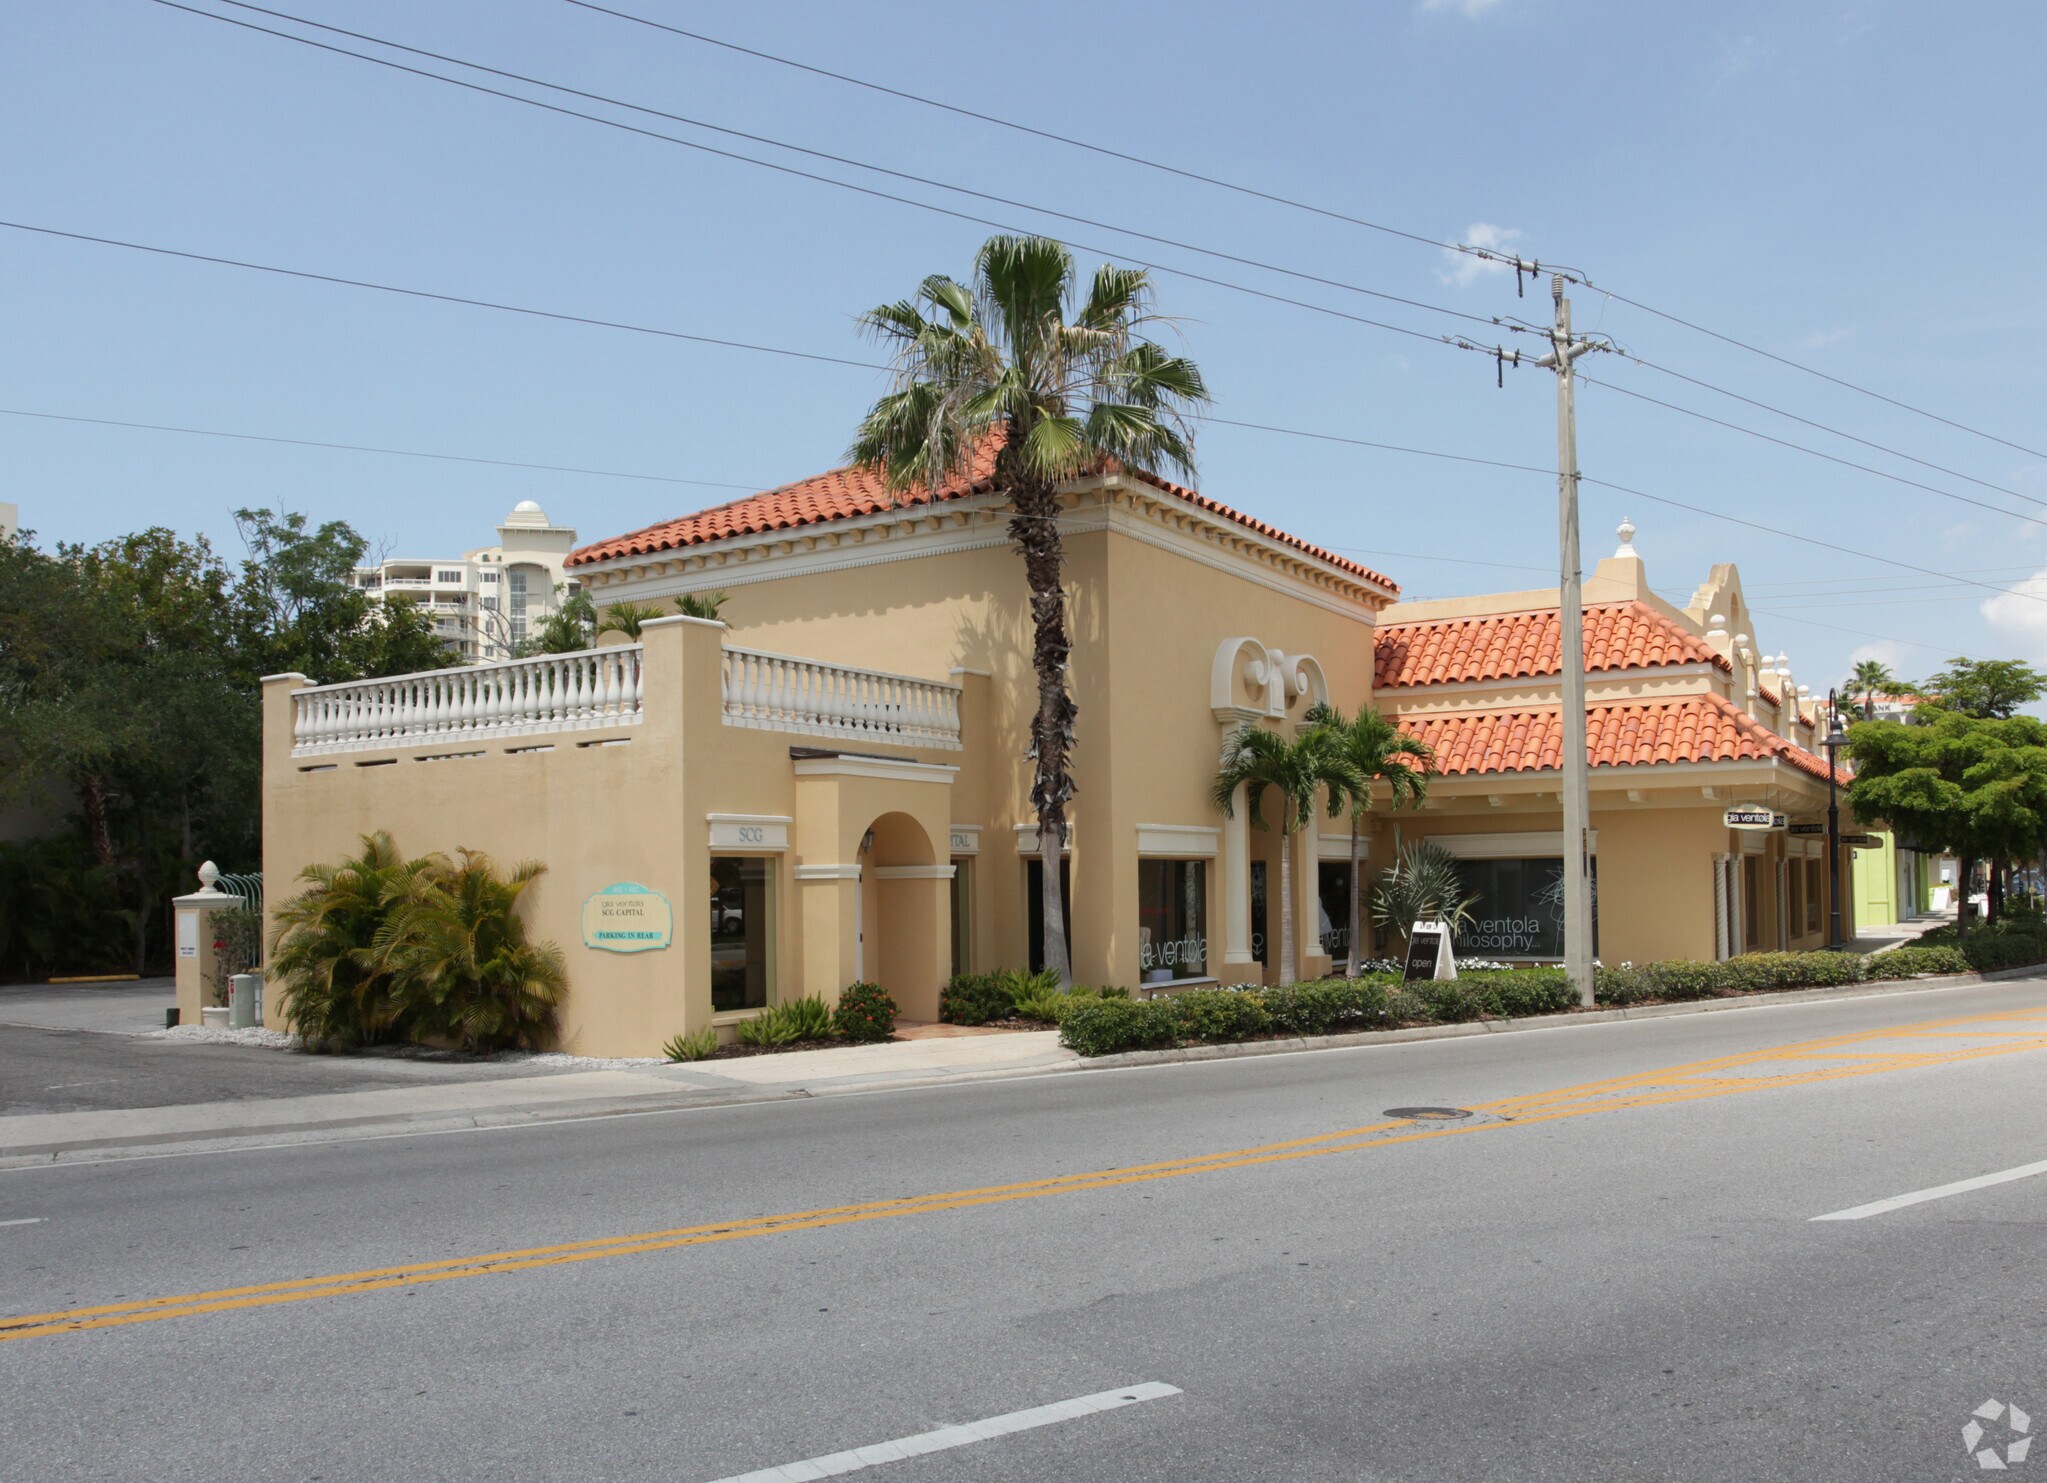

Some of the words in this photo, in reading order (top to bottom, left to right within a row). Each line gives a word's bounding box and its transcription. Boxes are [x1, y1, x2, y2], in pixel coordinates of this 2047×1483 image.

[739, 827, 763, 842] SCG
[616, 908, 644, 916] CAPITAL
[1452, 932, 1541, 952] hilosophy...
[1411, 959, 1432, 970] open
